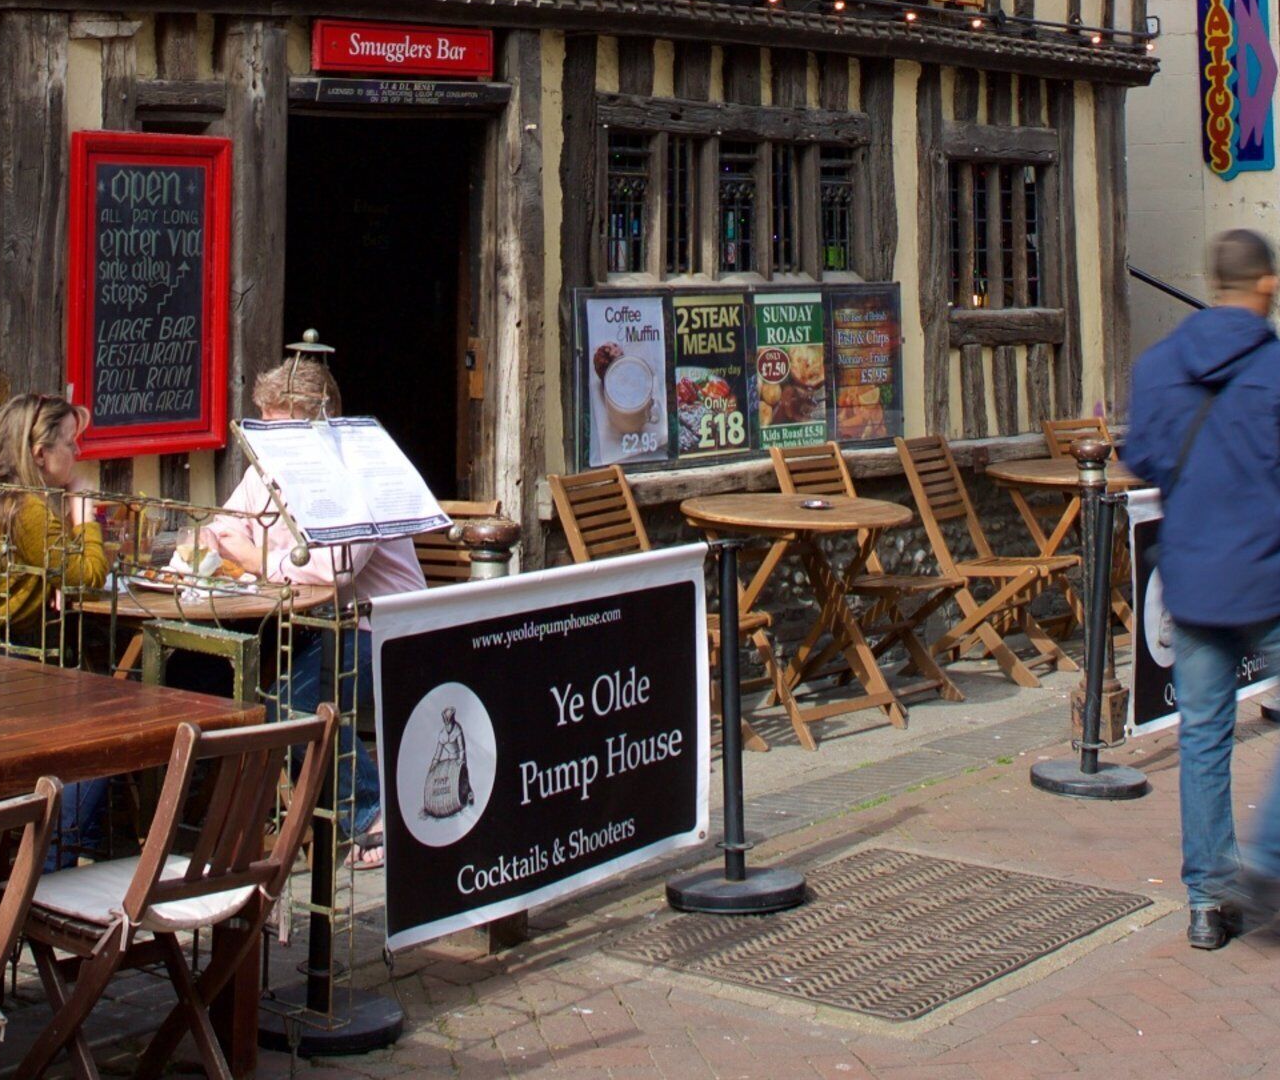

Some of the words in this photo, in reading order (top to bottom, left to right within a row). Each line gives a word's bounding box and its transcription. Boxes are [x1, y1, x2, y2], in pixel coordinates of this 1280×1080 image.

[349, 32, 432, 63] Smugglers
[436, 38, 467, 60] Bar
[111, 170, 181, 209] open
[100, 208, 122, 223] ALL
[132, 208, 159, 223] DAY
[163, 209, 199, 225] LONG
[100, 224, 161, 258] enter
[167, 228, 202, 258] via
[99, 257, 128, 281] side
[132, 256, 171, 288] alley
[101, 280, 148, 312] steps
[605, 306, 642, 324] Coffee
[676, 308, 690, 335] 2
[691, 306, 740, 329] STEAK
[762, 304, 814, 324] SUNDAY
[97, 318, 153, 343] LARGE
[159, 315, 196, 340] BAR
[625, 325, 660, 343] Muffin
[766, 325, 812, 344] ROAST
[837, 330, 856, 345] Fish
[857, 331, 865, 344] &
[866, 329, 890, 347] Chips
[96, 340, 199, 368] RESTAURANT
[683, 331, 736, 356] MEALS
[97, 368, 139, 393] POOL
[146, 365, 193, 390] ROOM
[762, 361, 787, 378] £7.50
[861, 368, 888, 383] £5.95
[95, 391, 154, 416] SMOKING
[155, 389, 195, 412] AREA
[622, 432, 658, 454] £2.95
[698, 411, 746, 449] £18
[762, 429, 780, 442] Kids
[782, 426, 803, 439] Roast
[471, 607, 622, 650] www.yeoldepumphouse.com
[549, 683, 585, 727] Ye
[591, 666, 651, 717] Olde
[519, 754, 599, 806] Pump
[605, 727, 683, 778] House
[456, 847, 549, 895] Cocktails
[552, 838, 567, 865] &
[569, 817, 636, 860] Shooters
